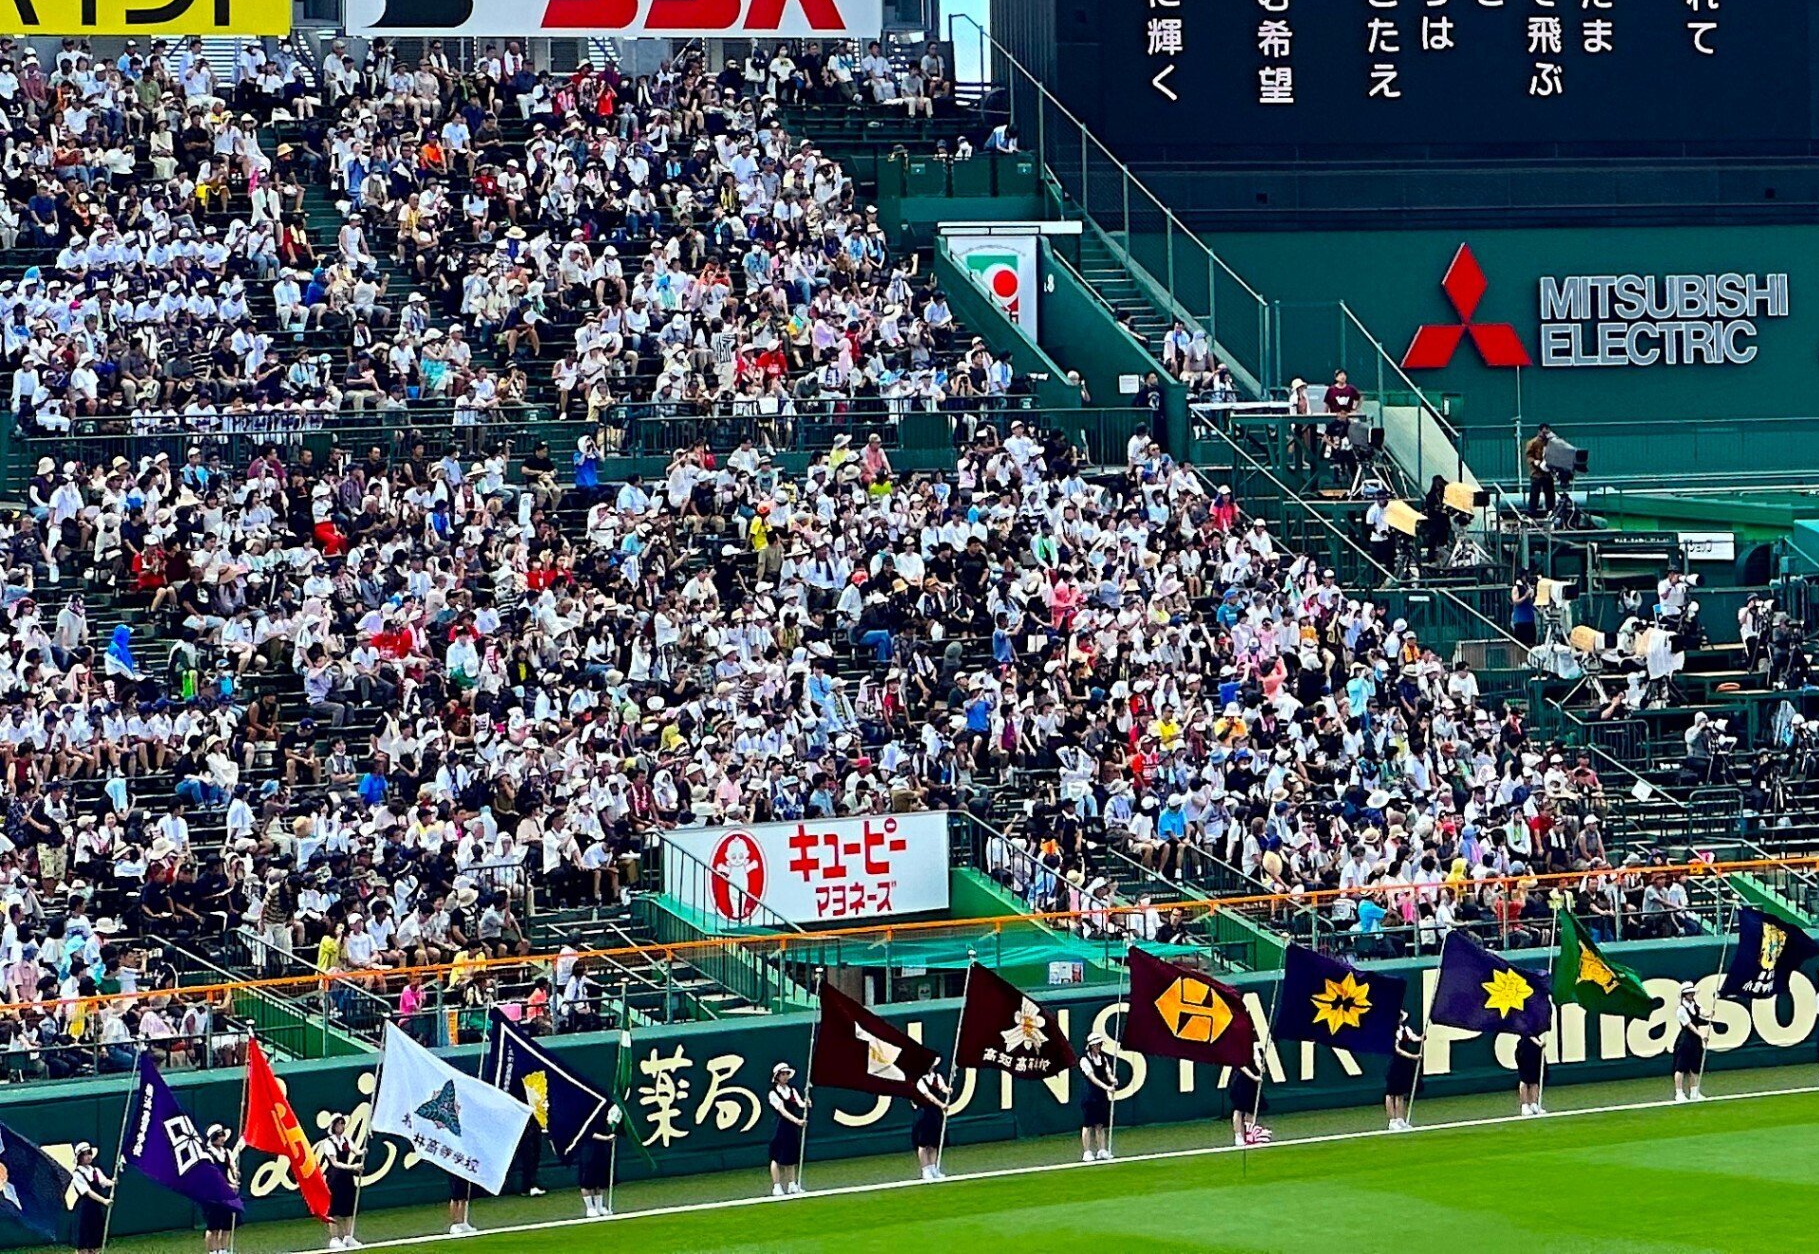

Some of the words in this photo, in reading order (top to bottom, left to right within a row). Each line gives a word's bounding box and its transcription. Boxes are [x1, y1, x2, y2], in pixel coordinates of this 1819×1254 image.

[1541, 274, 1788, 320] MITSUBISHI
[1541, 321, 1758, 366] ELECTRIC
[789, 814, 907, 882] キューピー
[816, 880, 897, 917] マヨネーズ
[638, 1044, 762, 1148] 薬局
